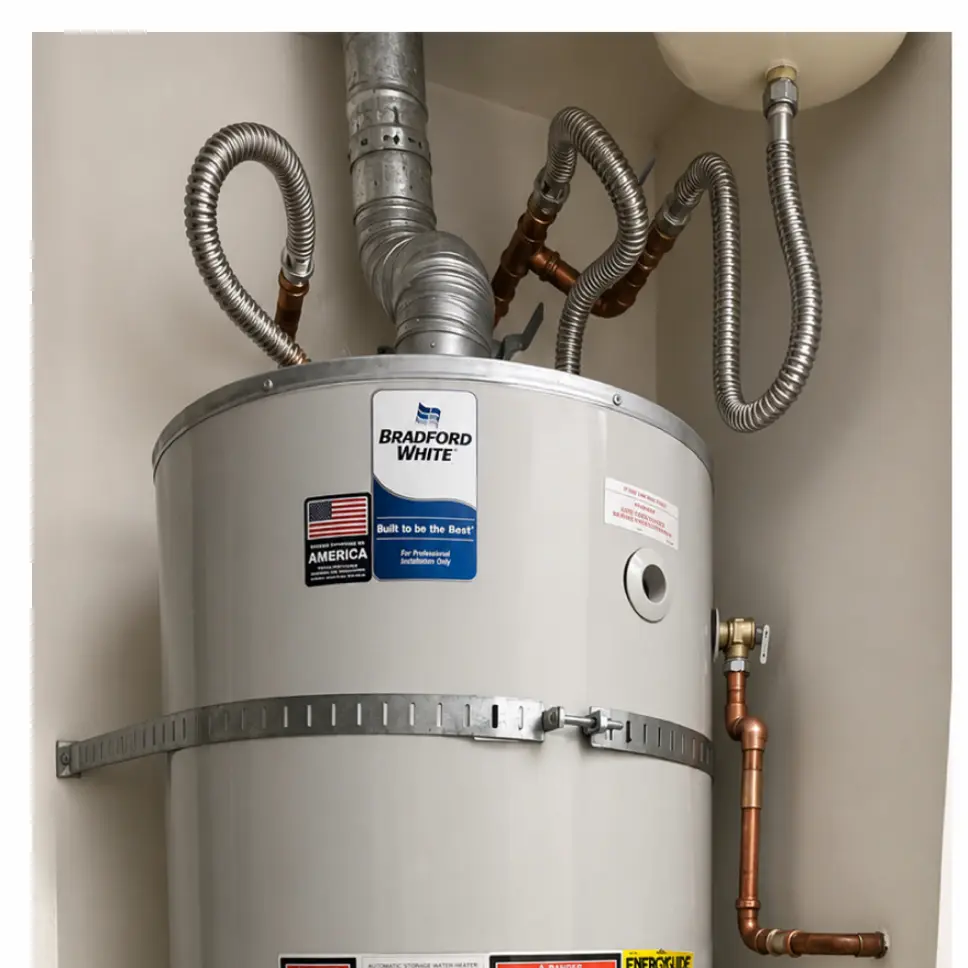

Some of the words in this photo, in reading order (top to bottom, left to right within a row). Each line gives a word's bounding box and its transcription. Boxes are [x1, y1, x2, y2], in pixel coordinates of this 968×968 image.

[379, 429, 472, 446] BRADFORD
[397, 445, 453, 461] WHITE
[376, 524, 399, 533] Built
[401, 524, 413, 533] to
[414, 524, 427, 533] be
[429, 524, 445, 533] the
[308, 548, 368, 564] AMERICA
[400, 549, 411, 557] For
[436, 558, 451, 567] Only
